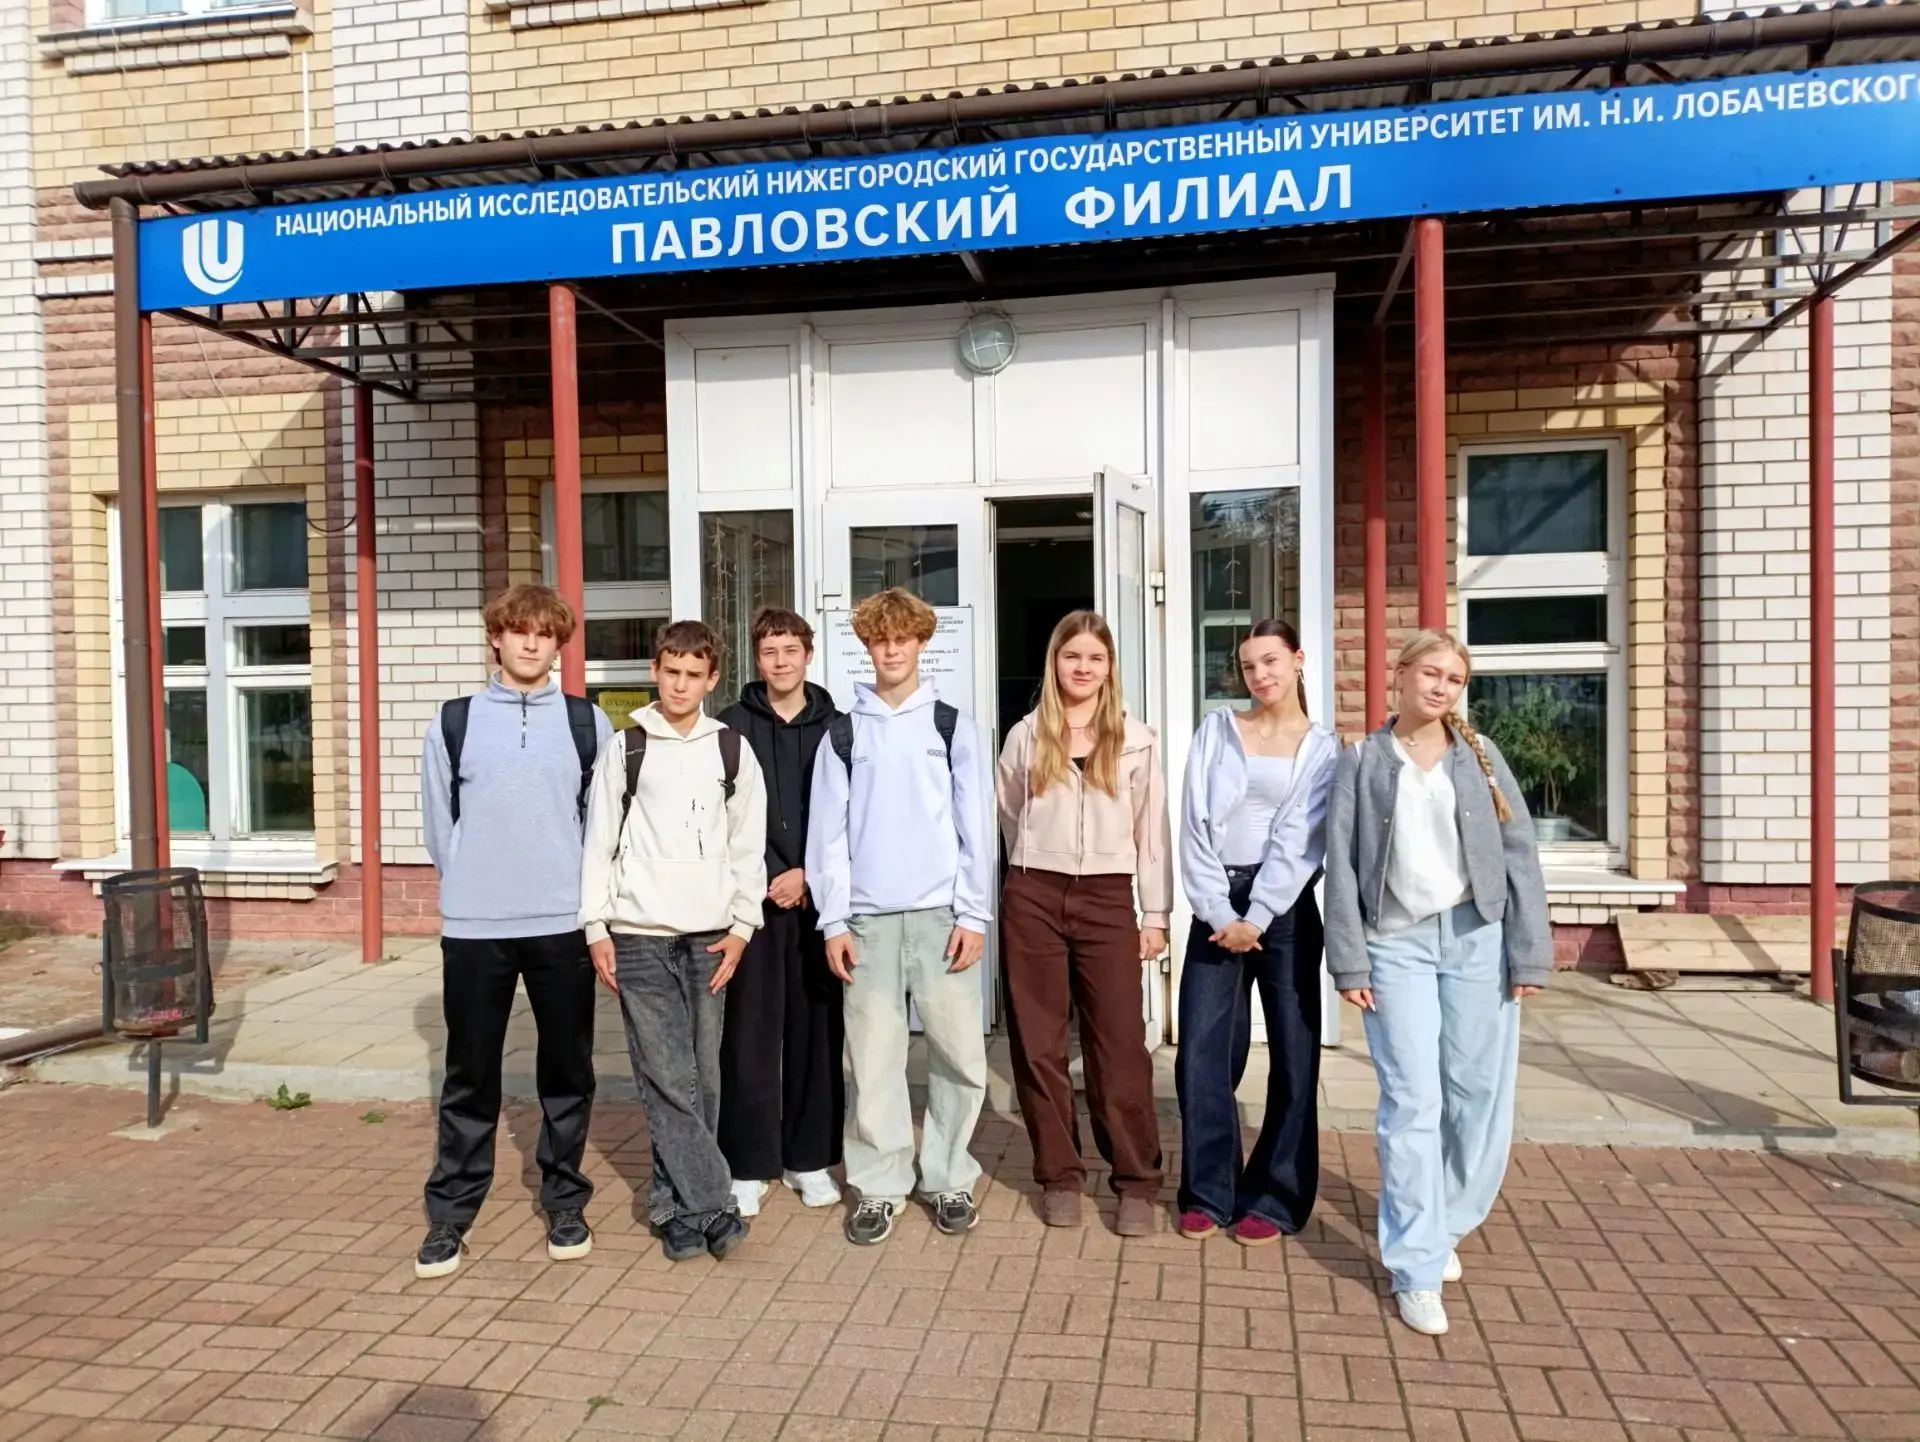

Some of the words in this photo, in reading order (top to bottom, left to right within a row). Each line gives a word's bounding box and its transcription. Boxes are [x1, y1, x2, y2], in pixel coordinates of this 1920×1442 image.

[275, 193, 473, 237] НАЦИОНАЛЬНЫЙ
[479, 168, 759, 218] ИССЛЕДОВАТЕЛЬСКИЙ
[767, 147, 1006, 195] НИЖЕГОРОДСКИЙ
[1014, 121, 1303, 174] ГОСУДАРСТВЕННЫЙ
[1309, 107, 1525, 150] УНИВЕРСИТЕТ
[1532, 102, 1591, 130] ИМ.
[1599, 96, 1665, 126] Н.И.
[1672, 71, 1920, 123] ЛОБАЧЕВСКОГ
[611, 184, 1018, 265] ПАВЛОВСКИЙ
[1064, 164, 1352, 230] ФИЛИАЛ
